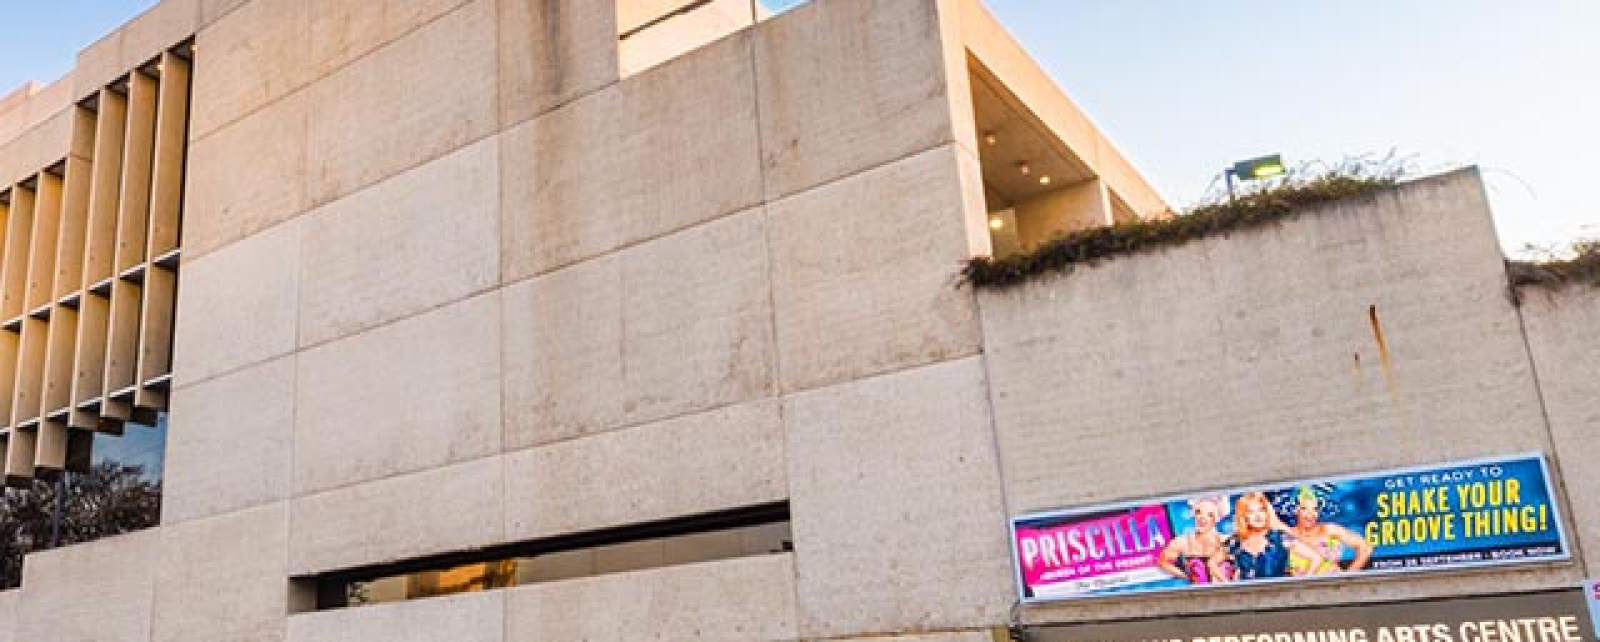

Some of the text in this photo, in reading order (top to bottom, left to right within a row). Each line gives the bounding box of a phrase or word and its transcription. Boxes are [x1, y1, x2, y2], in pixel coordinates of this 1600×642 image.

[1480, 466, 1503, 478] TO
[1377, 477, 1521, 518] SHAKE YOUR
[1021, 516, 1166, 571] PRISCILLA
[1364, 504, 1548, 546] GROOVE THING!
[1191, 615, 1583, 642] RMING ARTS CENTRE
